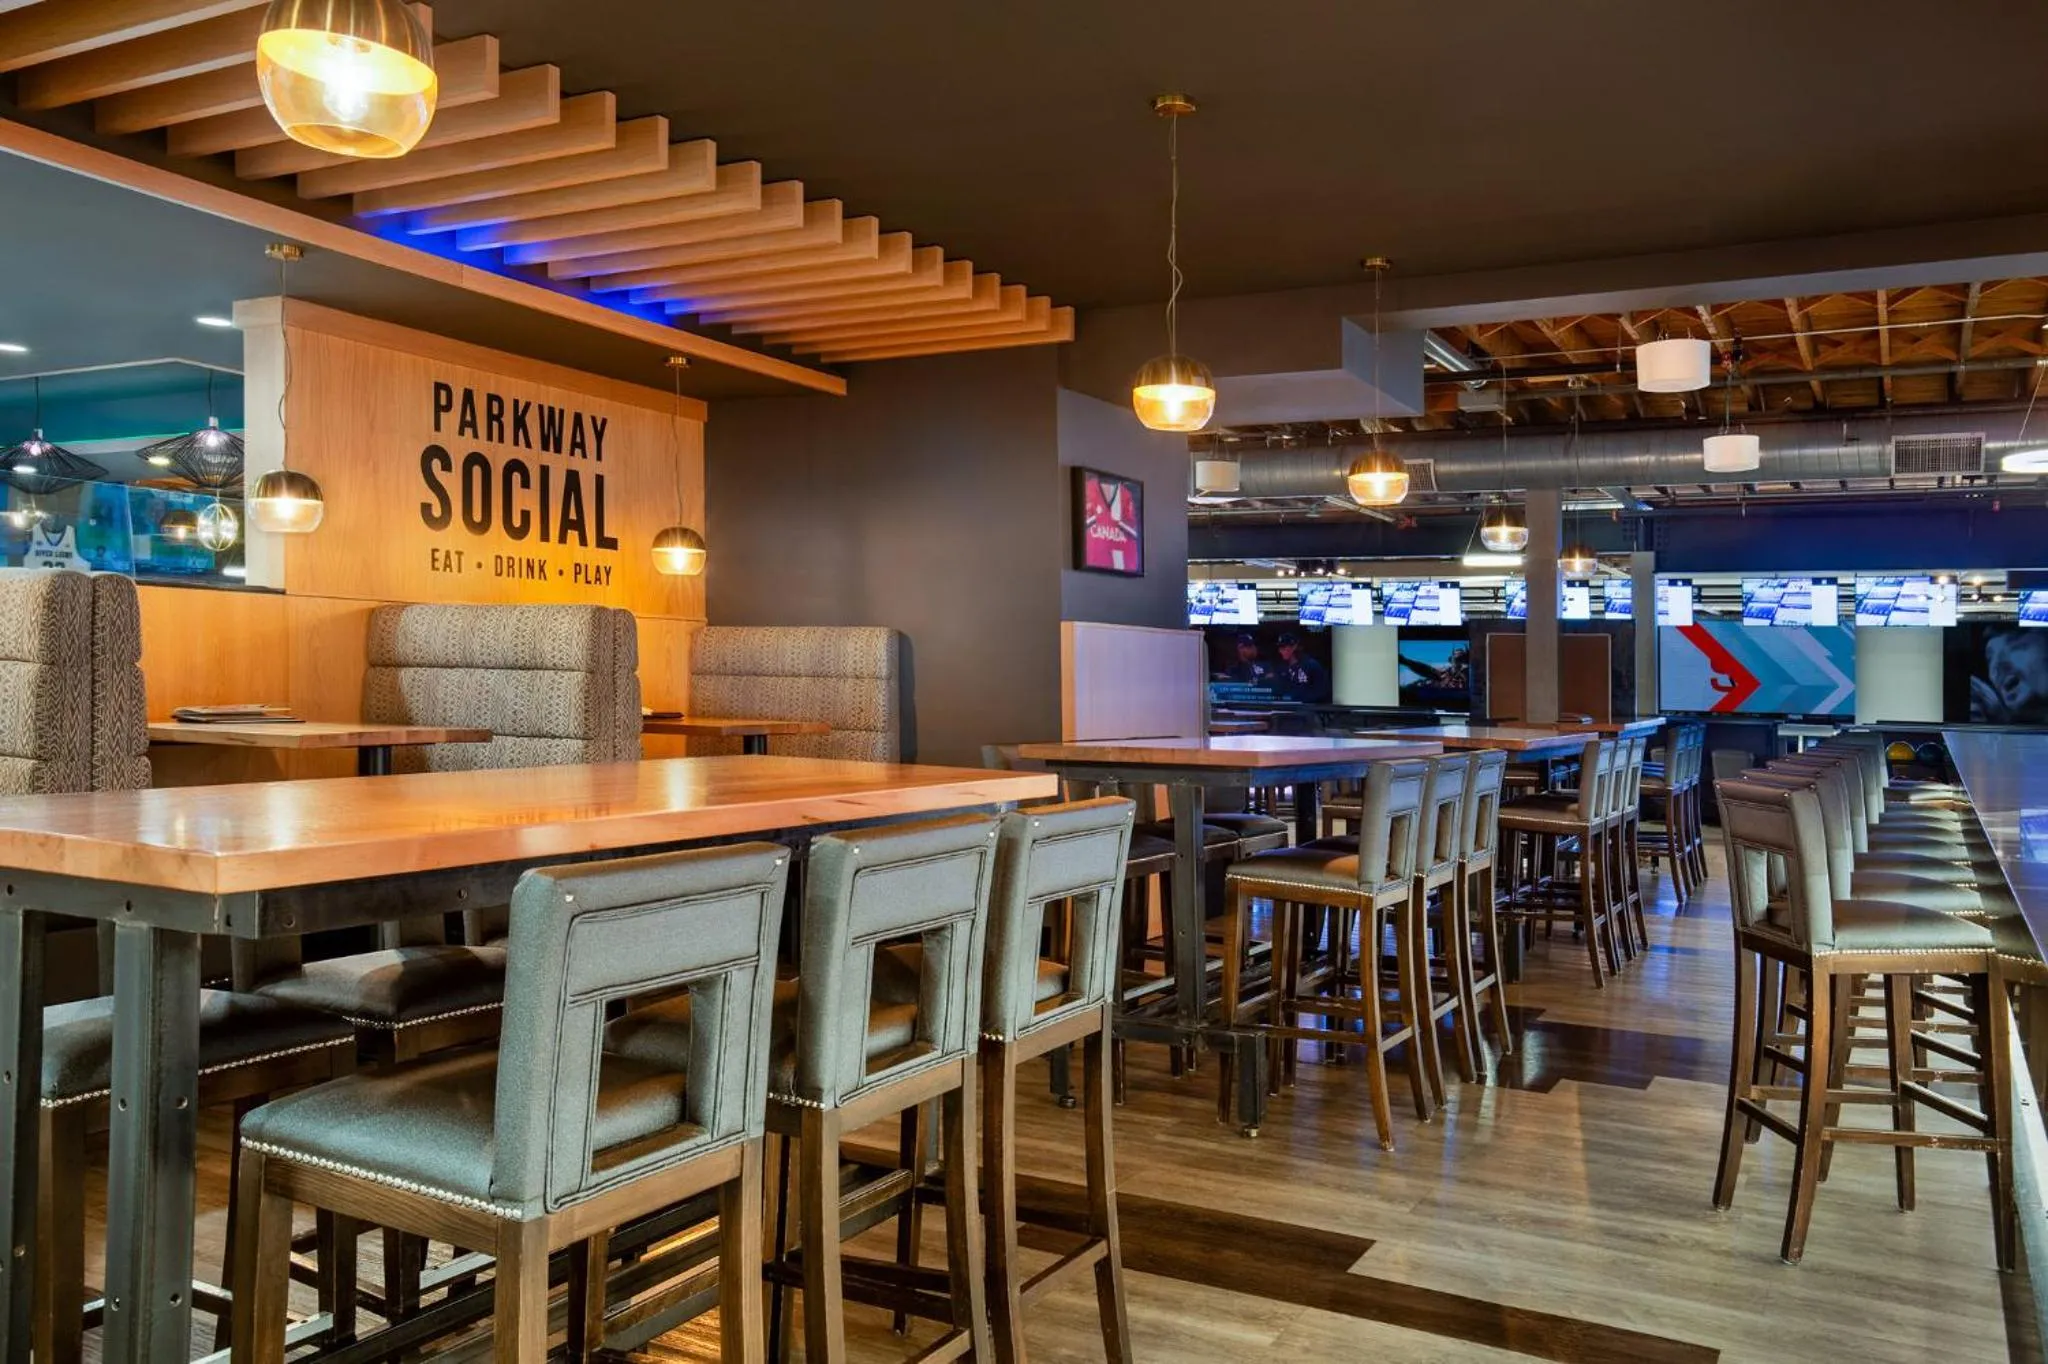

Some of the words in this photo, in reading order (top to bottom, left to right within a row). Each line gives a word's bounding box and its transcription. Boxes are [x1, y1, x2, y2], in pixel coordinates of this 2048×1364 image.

[433, 381, 607, 461] PARKWAY
[420, 444, 618, 550] SOCIAL
[1090, 525, 1127, 543] CANADA
[430, 548, 464, 573] EAT
[494, 554, 547, 581] DRINK
[573, 562, 612, 586] PLAY
